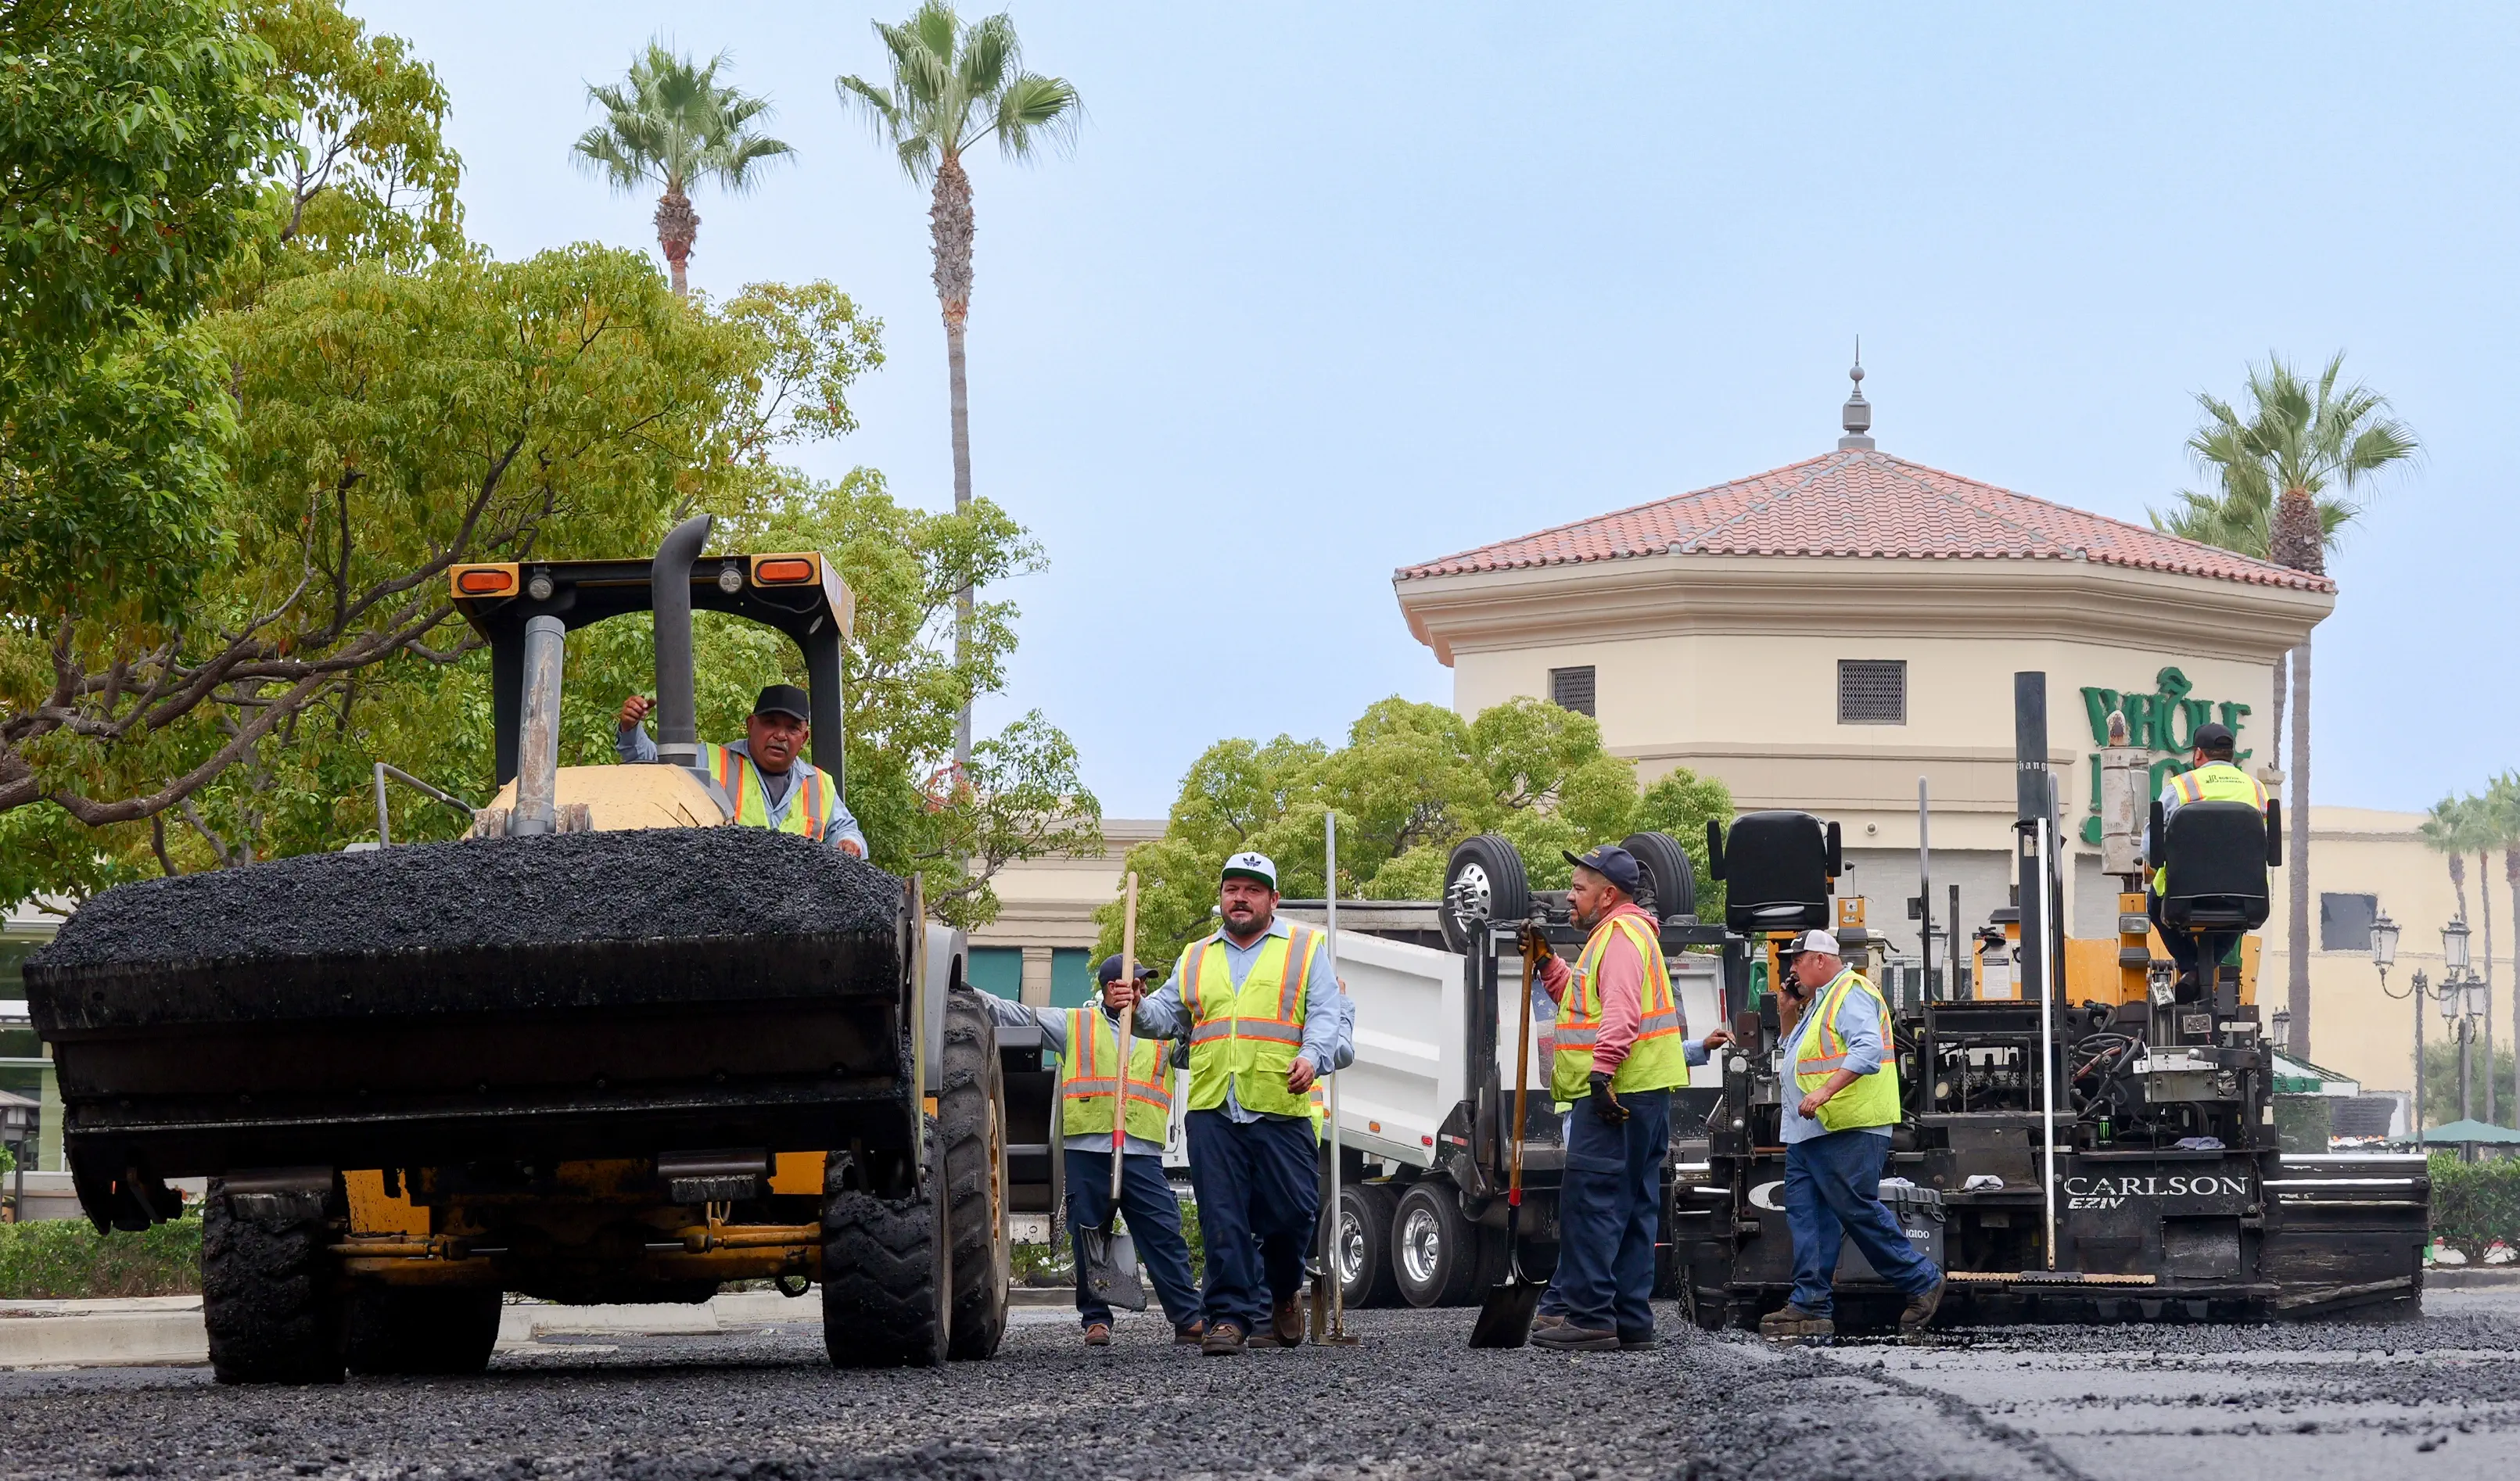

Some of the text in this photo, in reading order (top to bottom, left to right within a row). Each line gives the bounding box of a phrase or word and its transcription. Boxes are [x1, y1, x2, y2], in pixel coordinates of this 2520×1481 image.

[2064, 1177, 2249, 1196] CARLSON
[2068, 1197, 2125, 1210] EZIV
[1906, 1228, 1930, 1239] IGLOO
